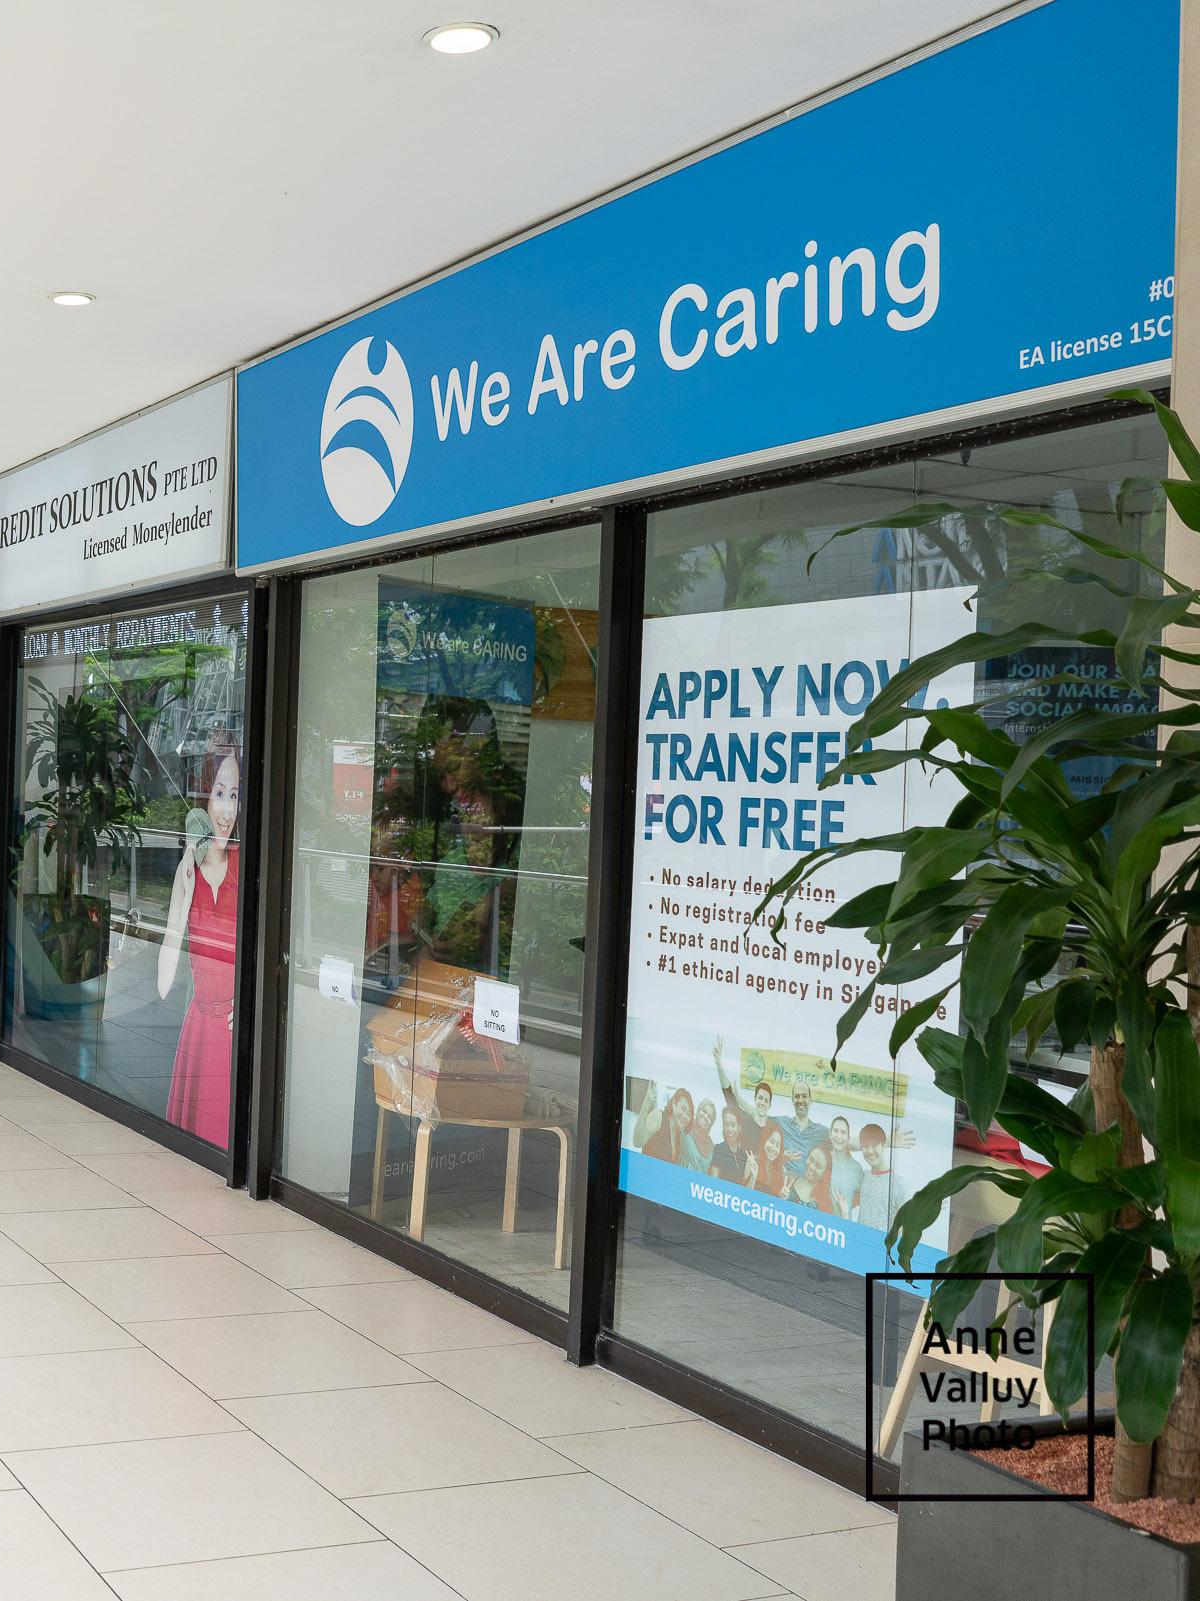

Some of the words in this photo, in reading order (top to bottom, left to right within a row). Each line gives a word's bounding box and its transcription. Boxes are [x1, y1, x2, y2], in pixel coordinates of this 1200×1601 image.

[430, 359, 511, 442] We
[527, 333, 636, 416] Are
[659, 222, 941, 372] Caring
[1019, 345, 1045, 370] EA
[1050, 331, 1123, 363] license
[1129, 314, 1174, 345] 15C
[49, 460, 158, 533] SOLUTIONS
[164, 466, 188, 497] PTE
[191, 456, 218, 488] LTD
[83, 527, 128, 560] Licensed
[132, 504, 213, 547] Moneylender
[473, 640, 527, 662] CARING
[1008, 664, 1055, 678] JOIN
[1063, 664, 1108, 678] OUR
[646, 665, 784, 720] APPLY
[1057, 683, 1119, 698] MAKE
[644, 793, 726, 845] FOR
[739, 797, 845, 854] FREE
[661, 868, 681, 886] No
[687, 872, 737, 897] salary
[660, 897, 680, 916] No
[795, 911, 826, 935] fee
[659, 926, 704, 949] Expat
[710, 935, 739, 954] and
[745, 937, 787, 961] local
[658, 954, 676, 974] #1
[682, 957, 739, 984] ethical
[746, 973, 809, 1001] agency
[816, 980, 833, 1001] in
[841, 983, 947, 1021] Sigape
[484, 1020, 506, 1033] SITTING
[490, 1009, 500, 1018] NO
[690, 1182, 846, 1248] wearecaring.com
